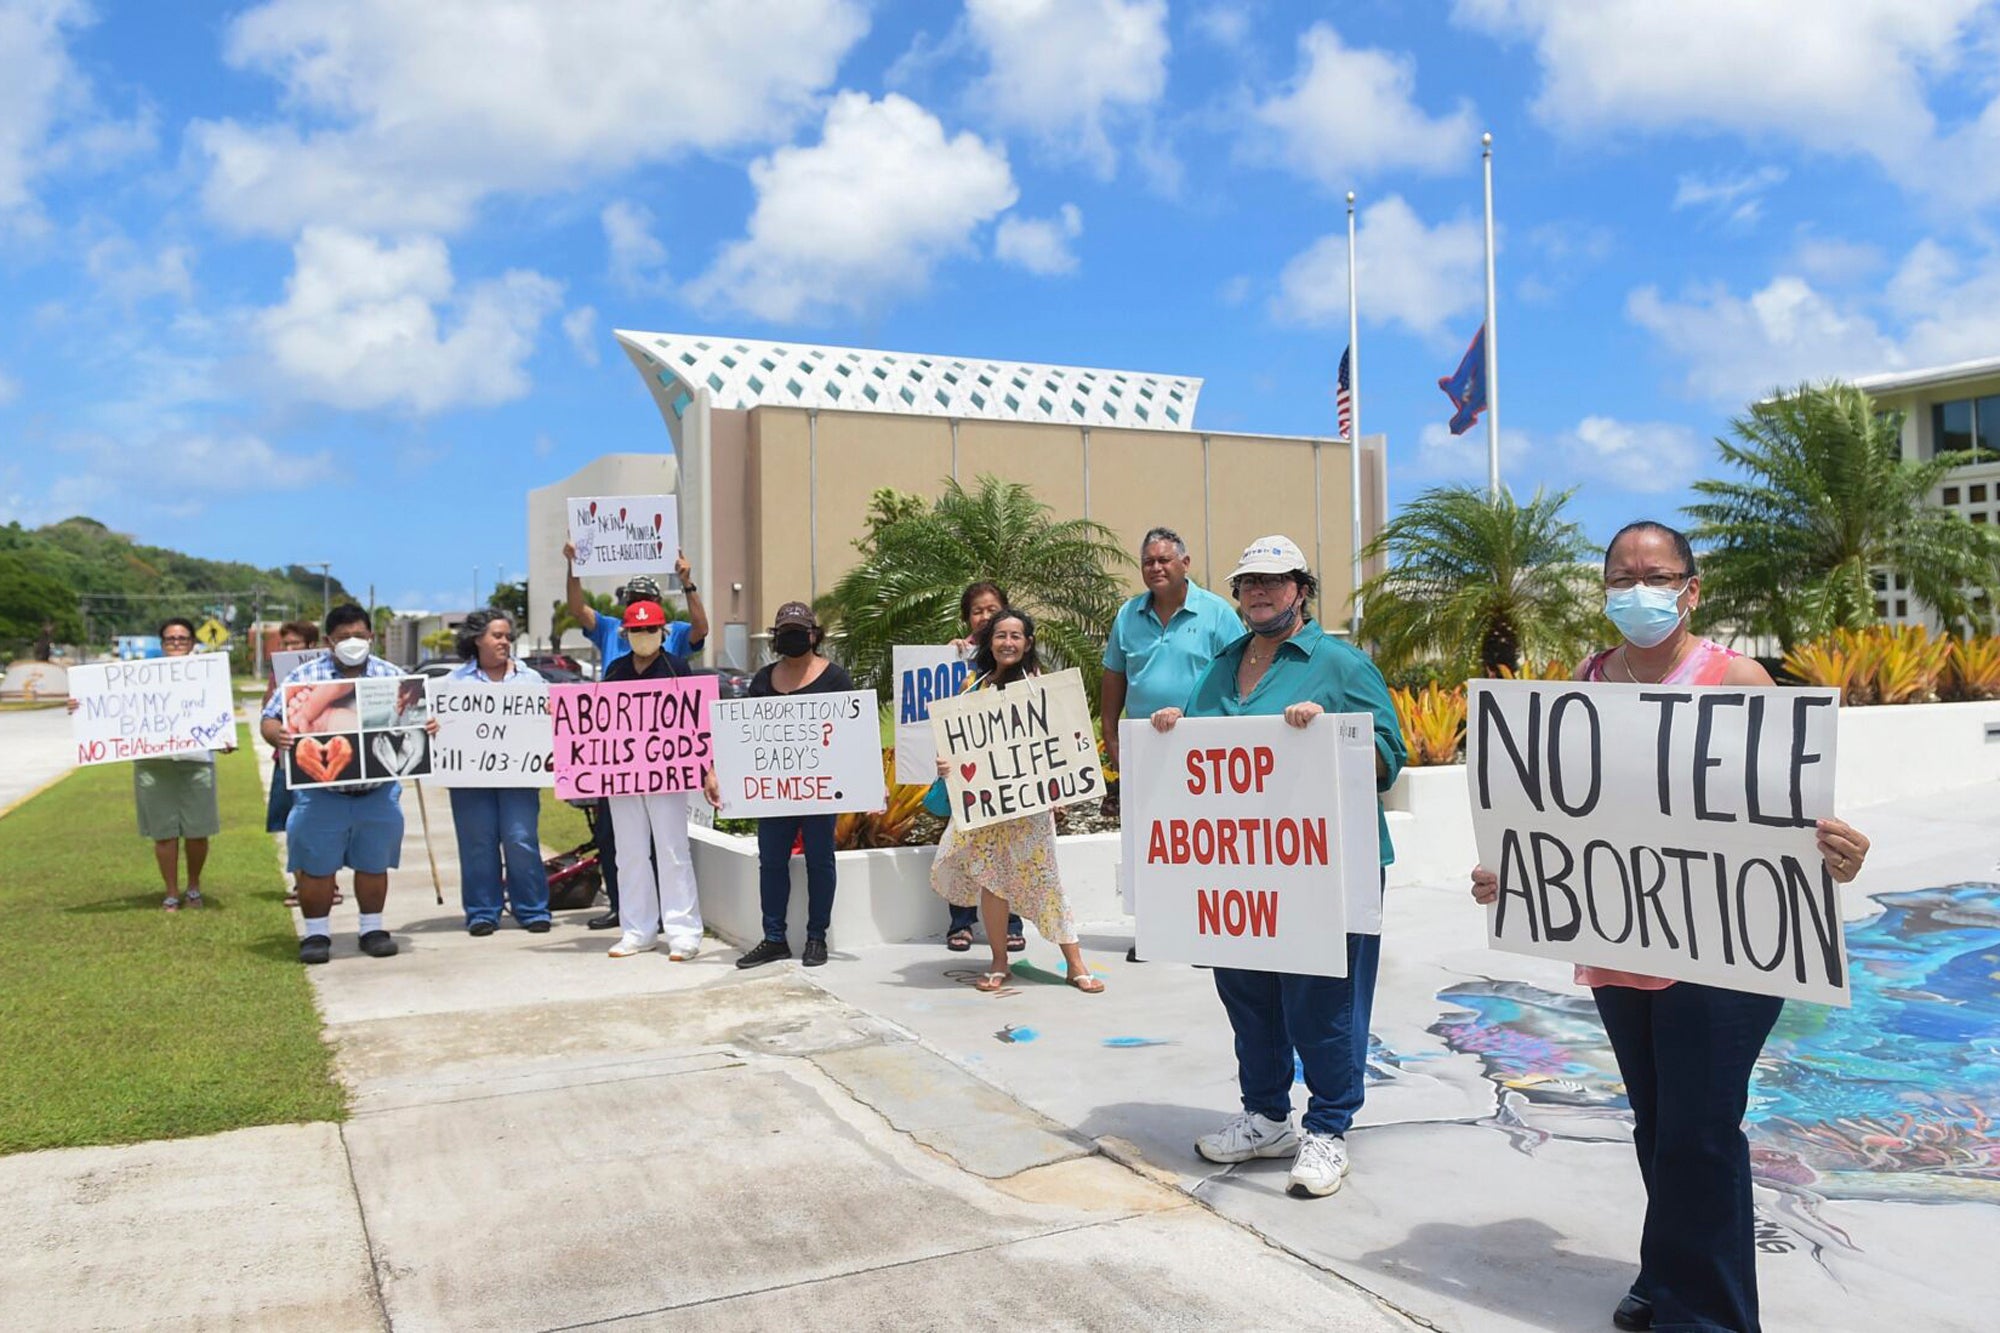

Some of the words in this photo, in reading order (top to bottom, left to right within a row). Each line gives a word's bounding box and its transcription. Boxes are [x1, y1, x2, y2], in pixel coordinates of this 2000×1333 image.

[104, 658, 218, 690] PROTECT
[86, 691, 171, 720] MOMMY
[181, 690, 206, 710] and
[431, 693, 496, 715] ECOND
[502, 694, 552, 716] HEAR
[554, 689, 702, 736] ABORTION
[716, 695, 860, 721] TELABORTION'S
[944, 687, 1049, 755] HUMAN
[78, 739, 106, 764] NO
[190, 710, 231, 746] Please
[476, 723, 507, 740] ON
[571, 738, 636, 766] KILLS
[645, 730, 712, 763] GOD'S
[740, 722, 833, 747] SUCCESS?
[754, 745, 820, 771] BABY'S
[988, 737, 1067, 781] LIFE
[1186, 746, 1274, 795] STOP
[1477, 690, 1601, 818] NO
[1639, 692, 1833, 829] TELE
[744, 776, 843, 801] DEMISE.
[962, 766, 1095, 823] PRECIOUS
[1148, 817, 1328, 866] ABORTION
[1197, 889, 1278, 938] NOW
[1494, 828, 1843, 988] ABORTION
